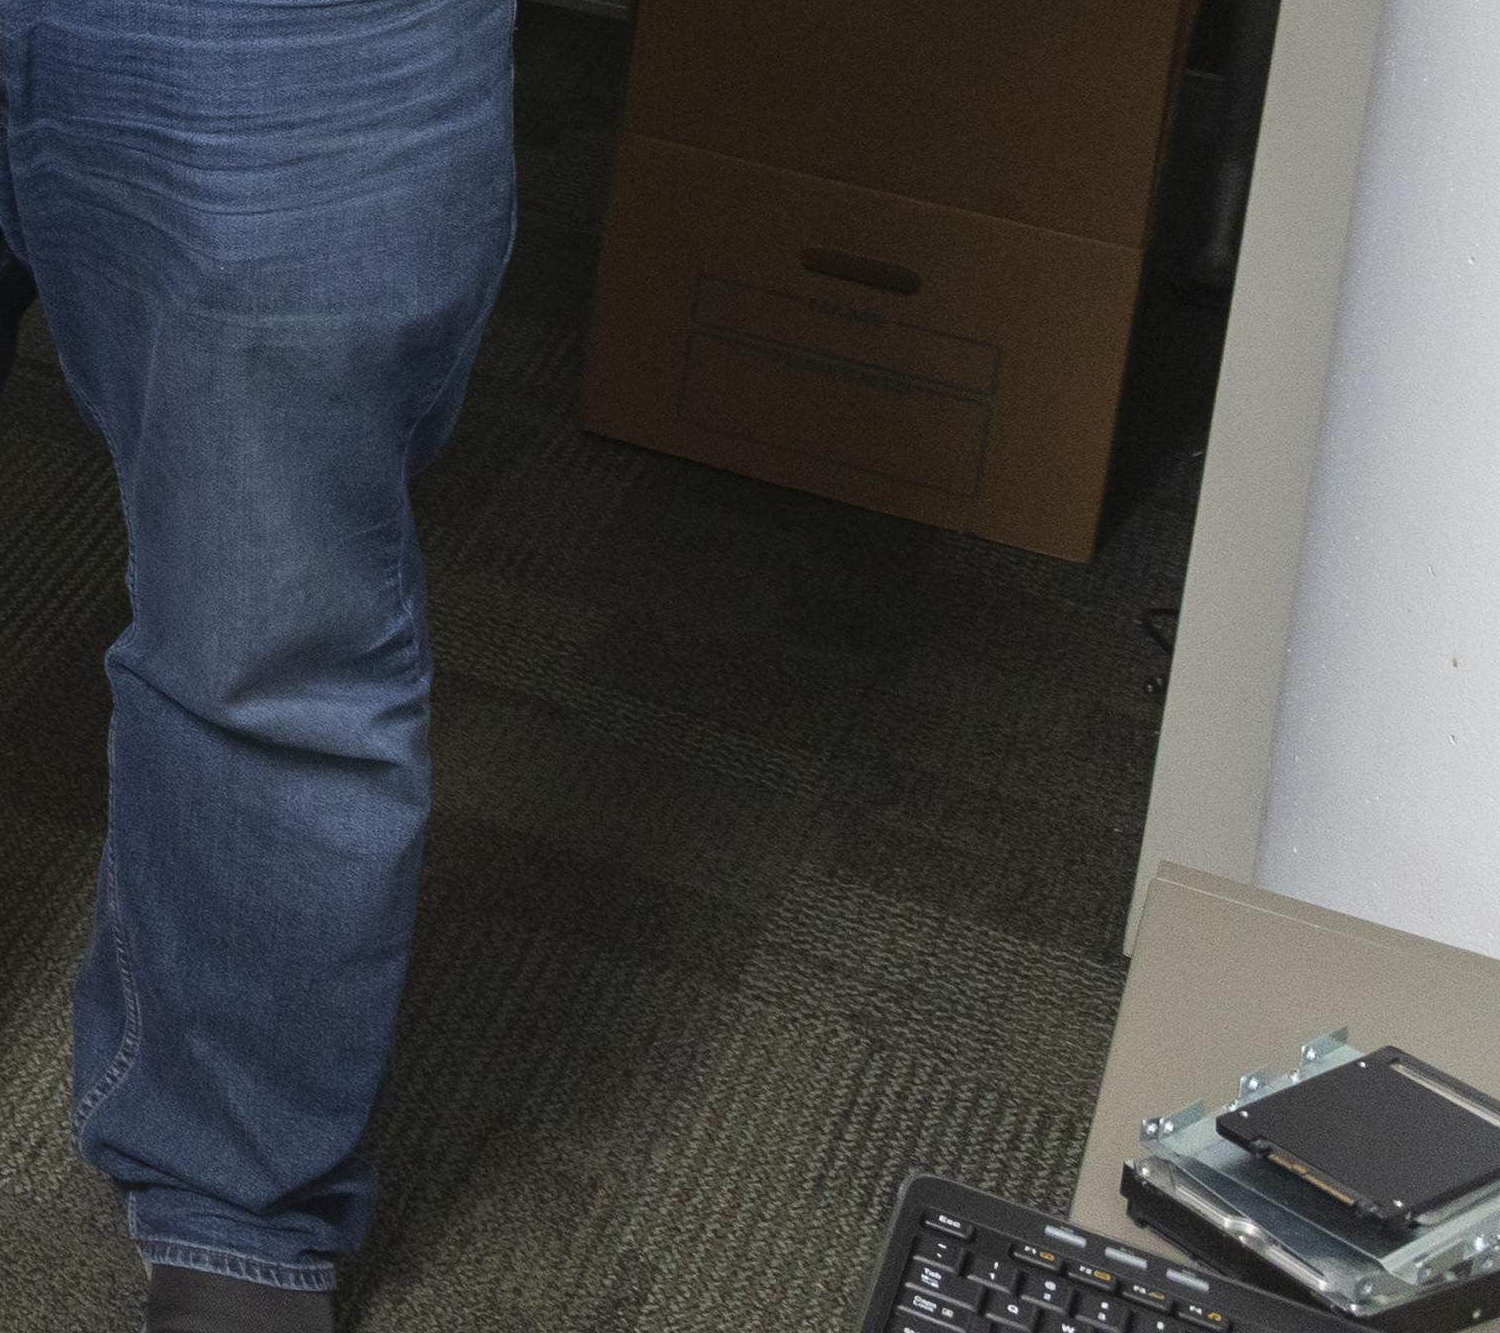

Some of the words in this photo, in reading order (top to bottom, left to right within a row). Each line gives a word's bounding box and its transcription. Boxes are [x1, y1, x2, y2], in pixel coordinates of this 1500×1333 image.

[939, 1214, 961, 1229] Esc
[923, 1266, 943, 1280] Tab
[1007, 1303, 1019, 1315] Q
